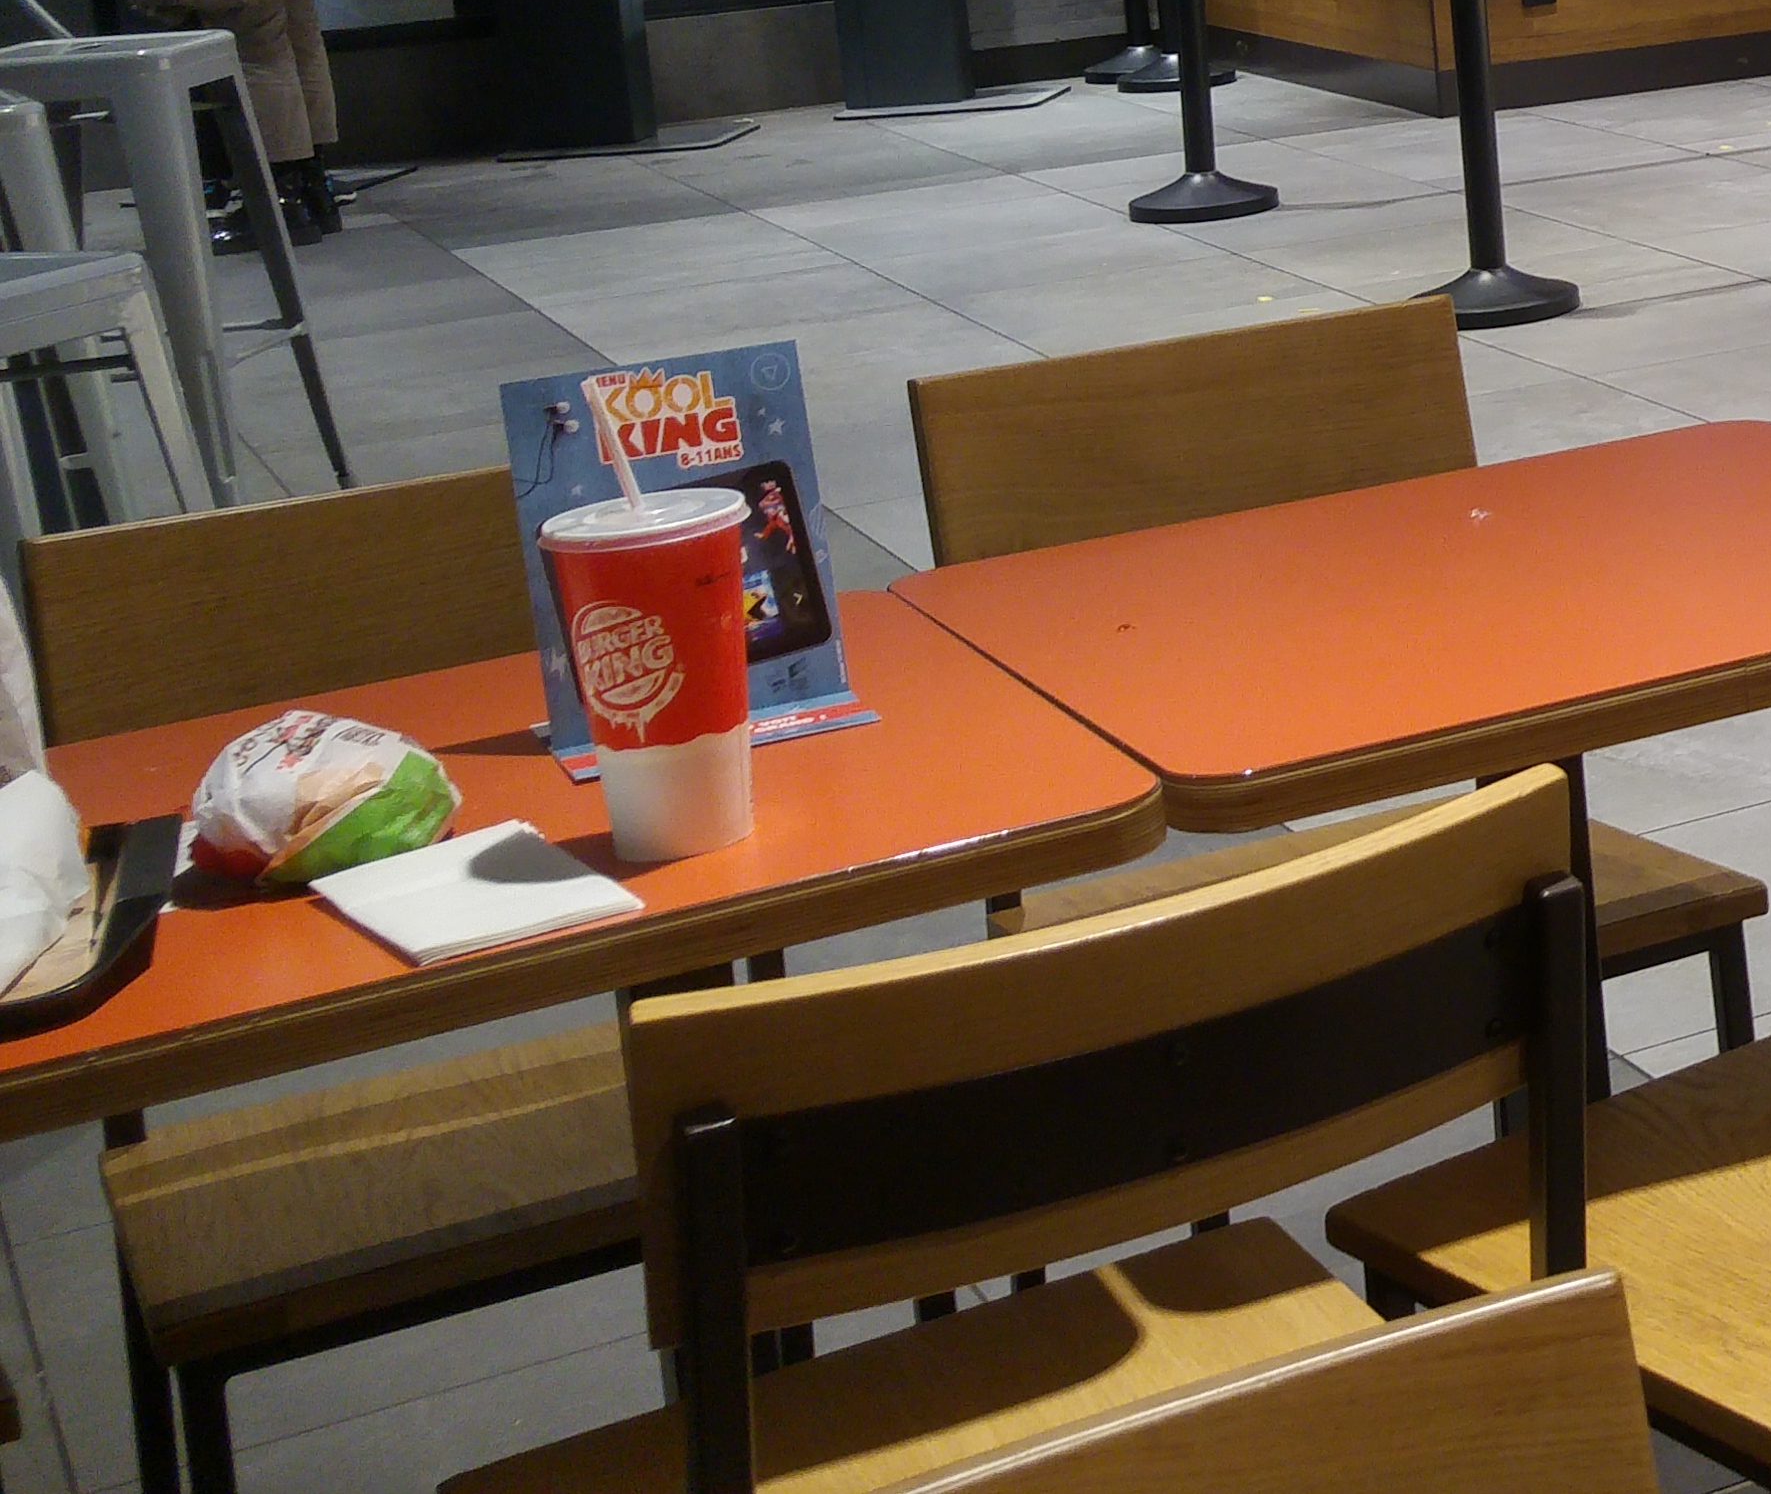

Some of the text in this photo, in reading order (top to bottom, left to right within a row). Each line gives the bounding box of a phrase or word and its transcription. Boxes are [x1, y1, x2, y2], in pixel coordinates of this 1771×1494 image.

[595, 373, 627, 388] ENU
[600, 407, 738, 462] KING
[582, 634, 675, 693] KING
